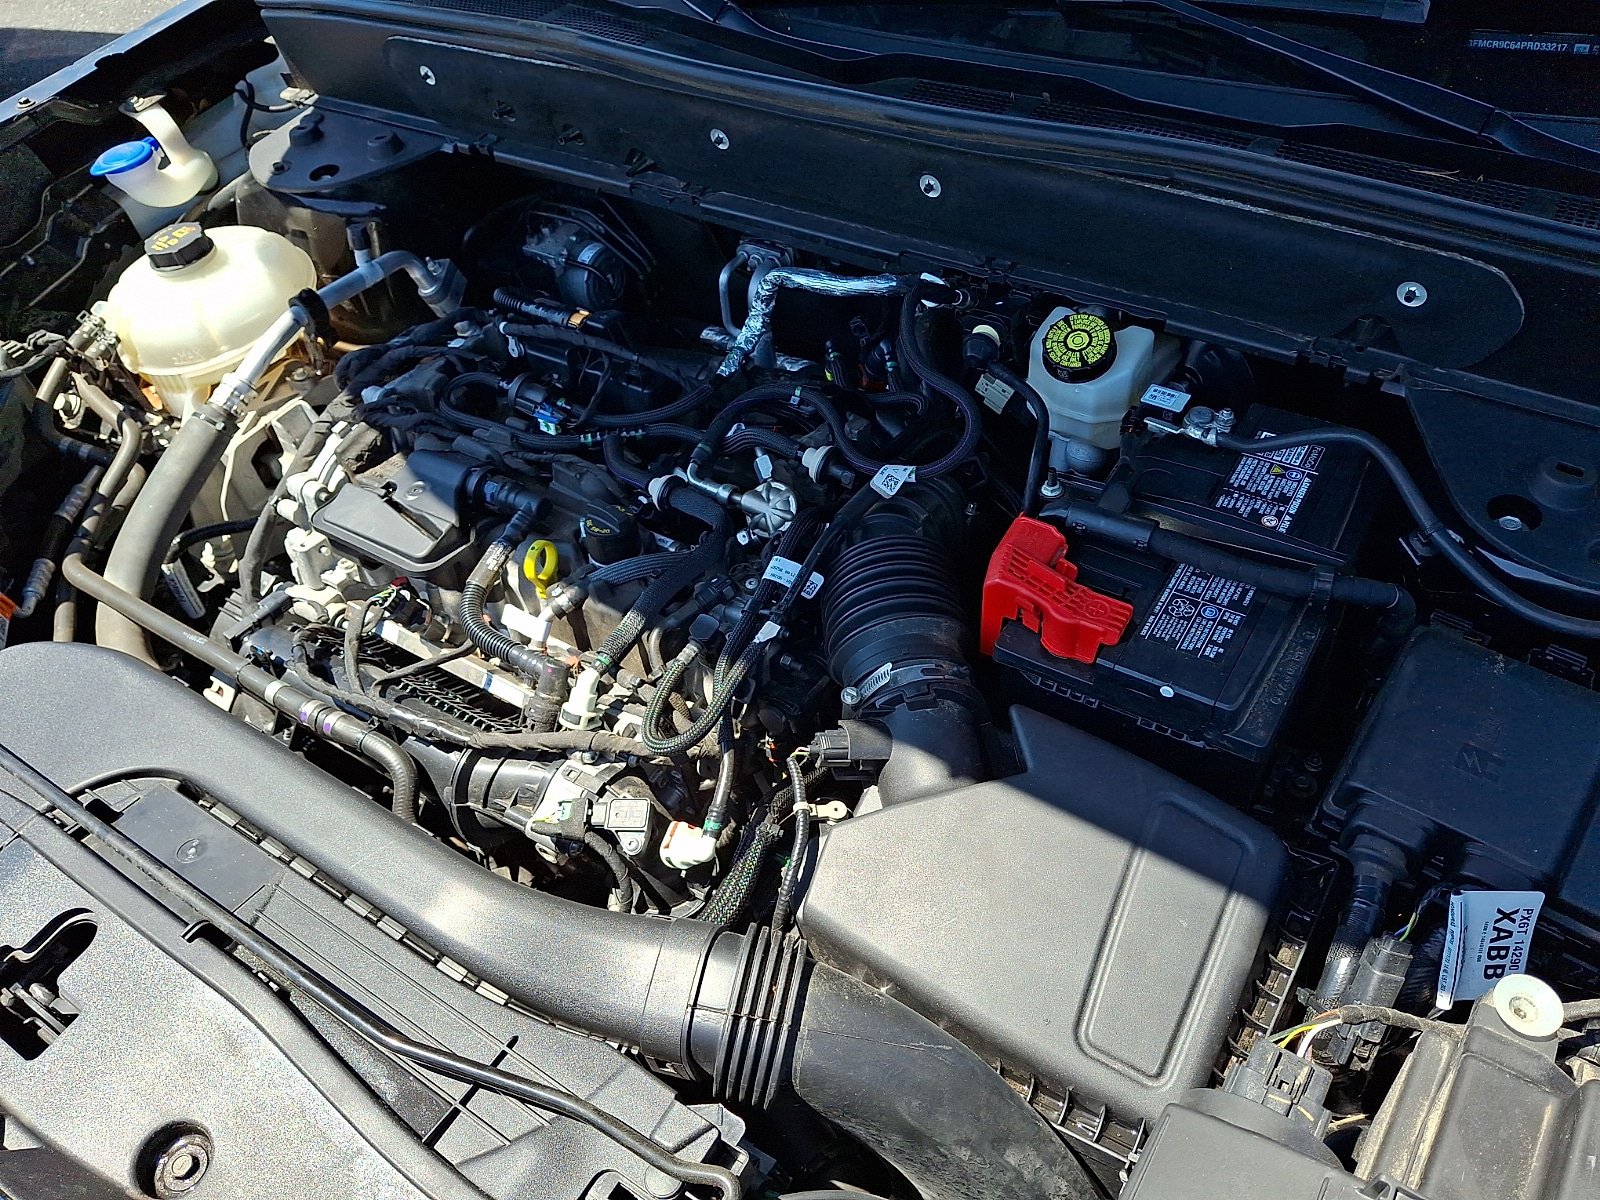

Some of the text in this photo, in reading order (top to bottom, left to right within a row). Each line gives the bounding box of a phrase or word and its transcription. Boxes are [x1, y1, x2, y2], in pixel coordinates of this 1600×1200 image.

[1483, 907, 1521, 980] XABB
[1508, 908, 1534, 971] PX6T 14290
